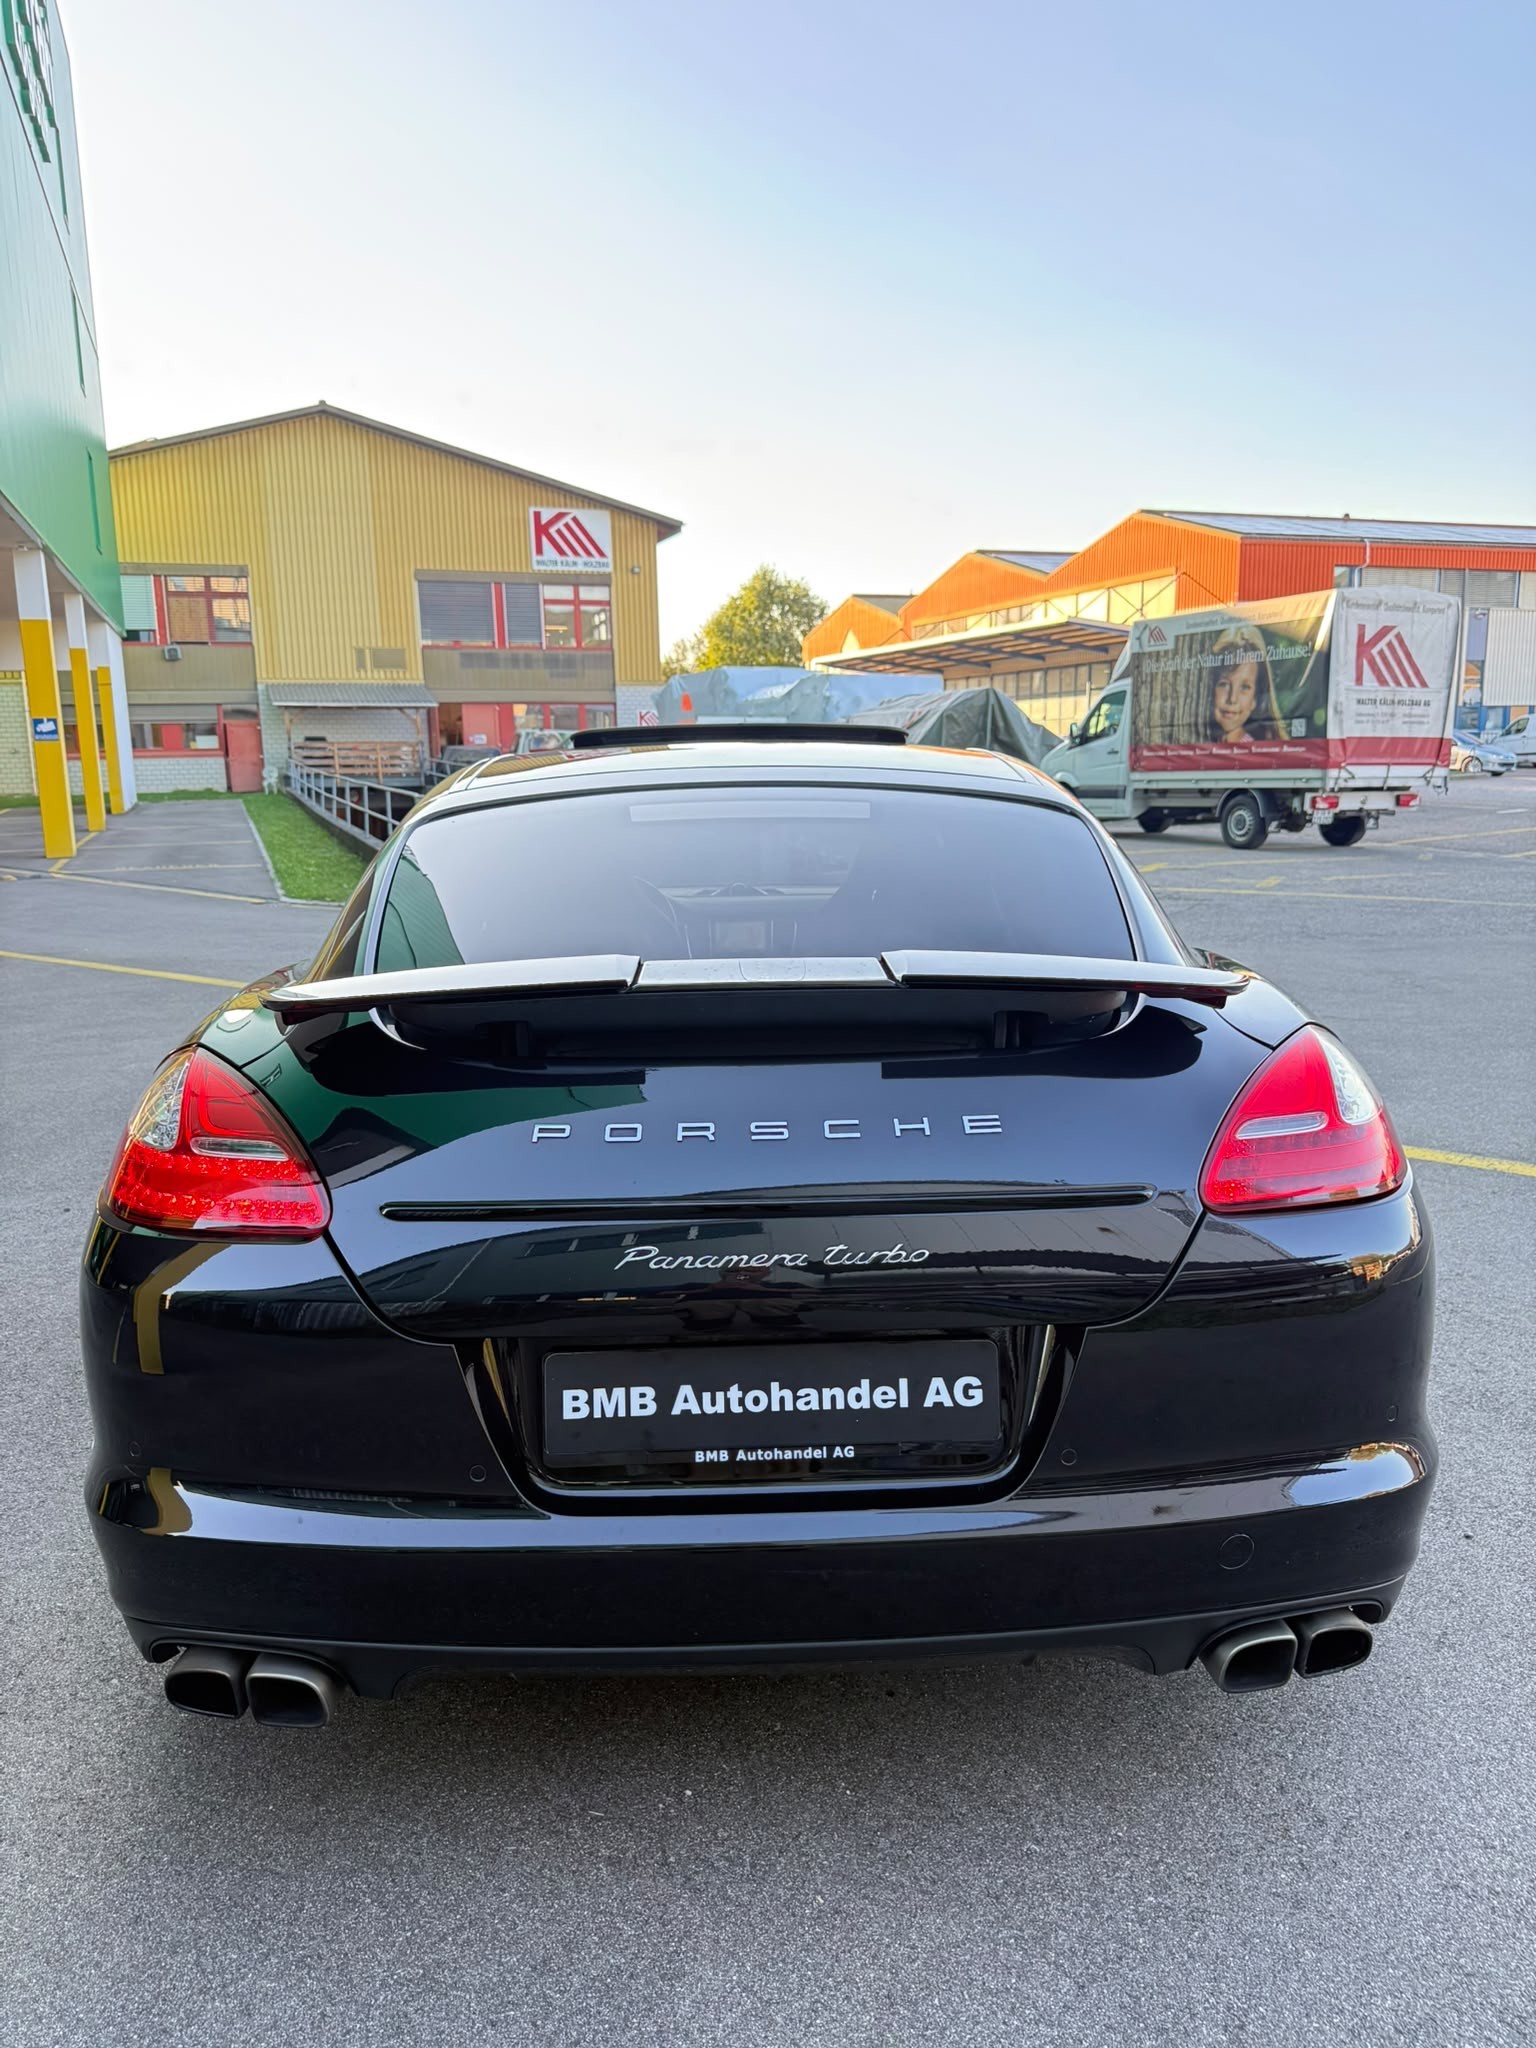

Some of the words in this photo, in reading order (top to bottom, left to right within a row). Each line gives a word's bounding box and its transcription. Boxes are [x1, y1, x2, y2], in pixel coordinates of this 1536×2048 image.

[1182, 656, 1196, 670] der
[1198, 653, 1223, 668] Natur
[1224, 651, 1235, 666] in
[1236, 648, 1264, 664] Ihrem
[1266, 641, 1312, 661] Zuhause!
[532, 1114, 1002, 1142] PORSCHE
[614, 1245, 808, 1270] Panamera
[824, 1243, 930, 1265] turbo
[562, 1386, 657, 1420] BMB
[670, 1377, 909, 1415] Autohandel
[923, 1376, 984, 1408] AG
[695, 1449, 729, 1463] BMB
[735, 1446, 827, 1461] Autohandel
[832, 1445, 855, 1459] AG
